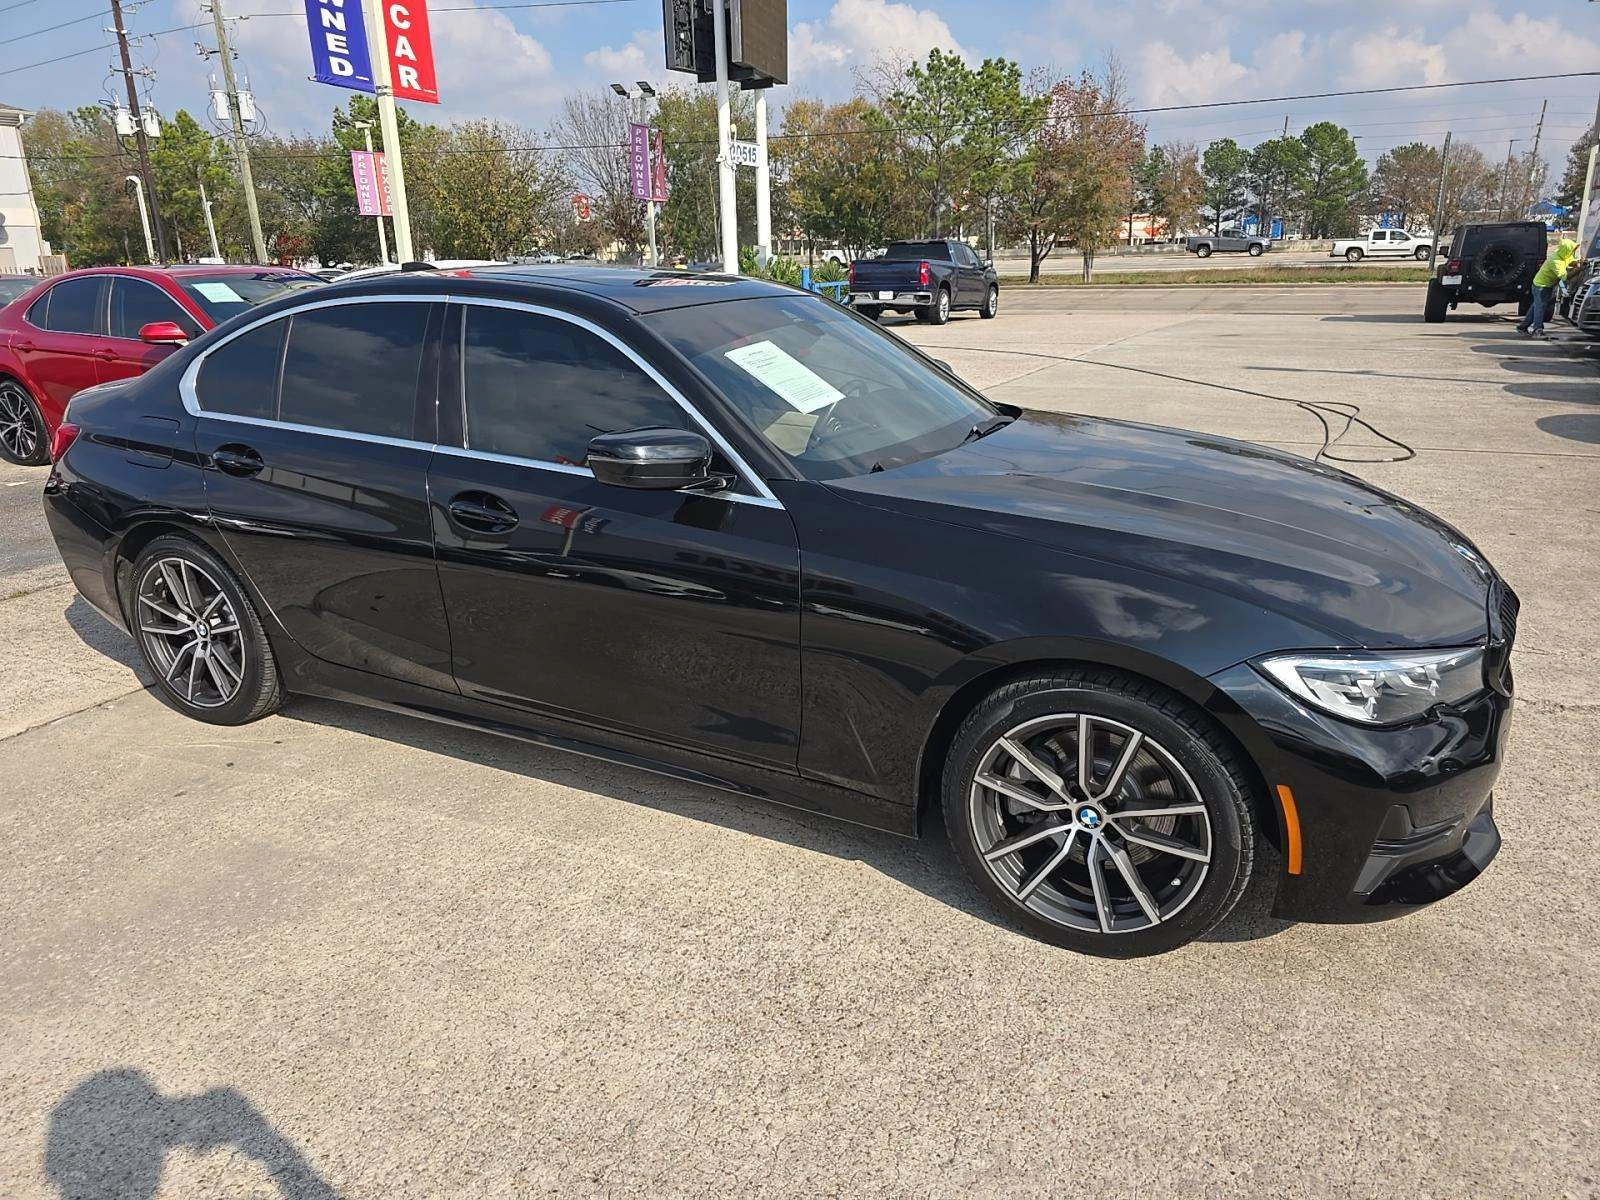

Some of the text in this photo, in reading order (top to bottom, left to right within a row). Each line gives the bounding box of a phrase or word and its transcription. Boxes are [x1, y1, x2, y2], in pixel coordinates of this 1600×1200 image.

[389, 4, 421, 90] CAR
[357, 154, 373, 212] PREOWNED
[634, 128, 646, 196] PREOWNED
